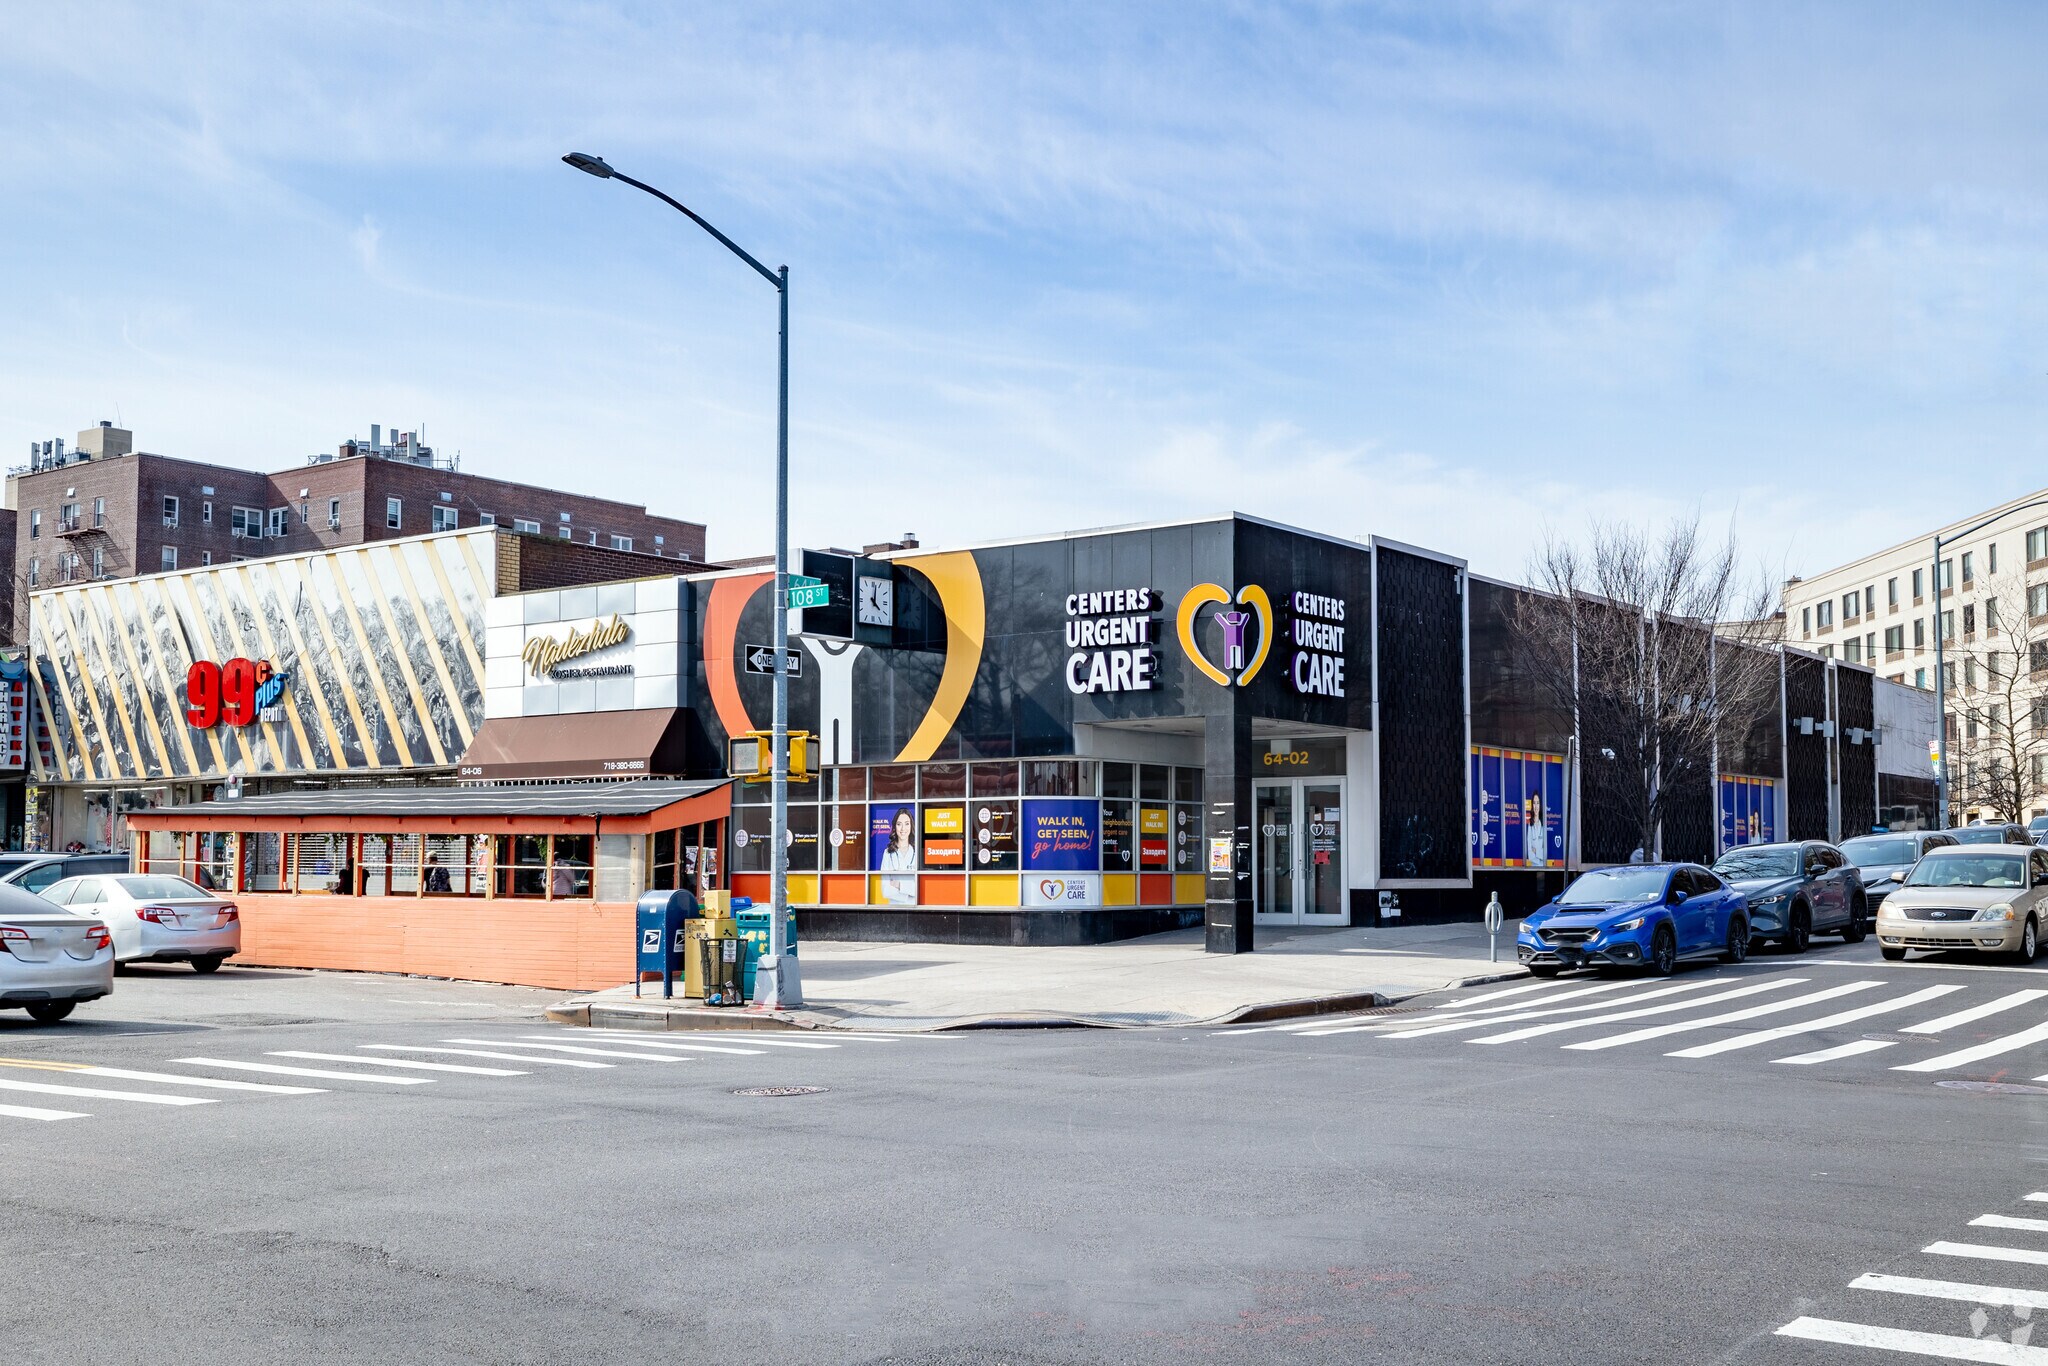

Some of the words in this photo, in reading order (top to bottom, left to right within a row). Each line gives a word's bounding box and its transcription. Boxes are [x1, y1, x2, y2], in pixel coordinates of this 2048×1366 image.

[792, 590, 814, 606] 108
[816, 588, 824, 596] ST
[1066, 588, 1150, 616] CENTERS
[1296, 591, 1345, 620] CENTERS
[1066, 616, 1150, 648] URGENT
[1296, 618, 1344, 652] URGENT
[520, 612, 630, 677] Nadezhda
[757, 654, 772, 667] ONE
[551, 668, 580, 679] KOSHER
[582, 664, 632, 678] RESTAURANT
[1066, 648, 1150, 694] CARE
[1295, 651, 1344, 698] CARE
[260, 707, 283, 722] DEPOT
[1264, 752, 1309, 766] 64-02
[462, 767, 482, 775] 64-06
[1037, 816, 1069, 826] WALK
[1072, 816, 1085, 827] IN,
[1037, 829, 1058, 838] GET
[1061, 829, 1090, 840] SEEN,
[927, 848, 960, 856] Заходите
[1032, 842, 1051, 860] go
[1053, 830, 1094, 852] home!
[1142, 848, 1166, 856] Заходите
[1067, 891, 1086, 899] CARE
